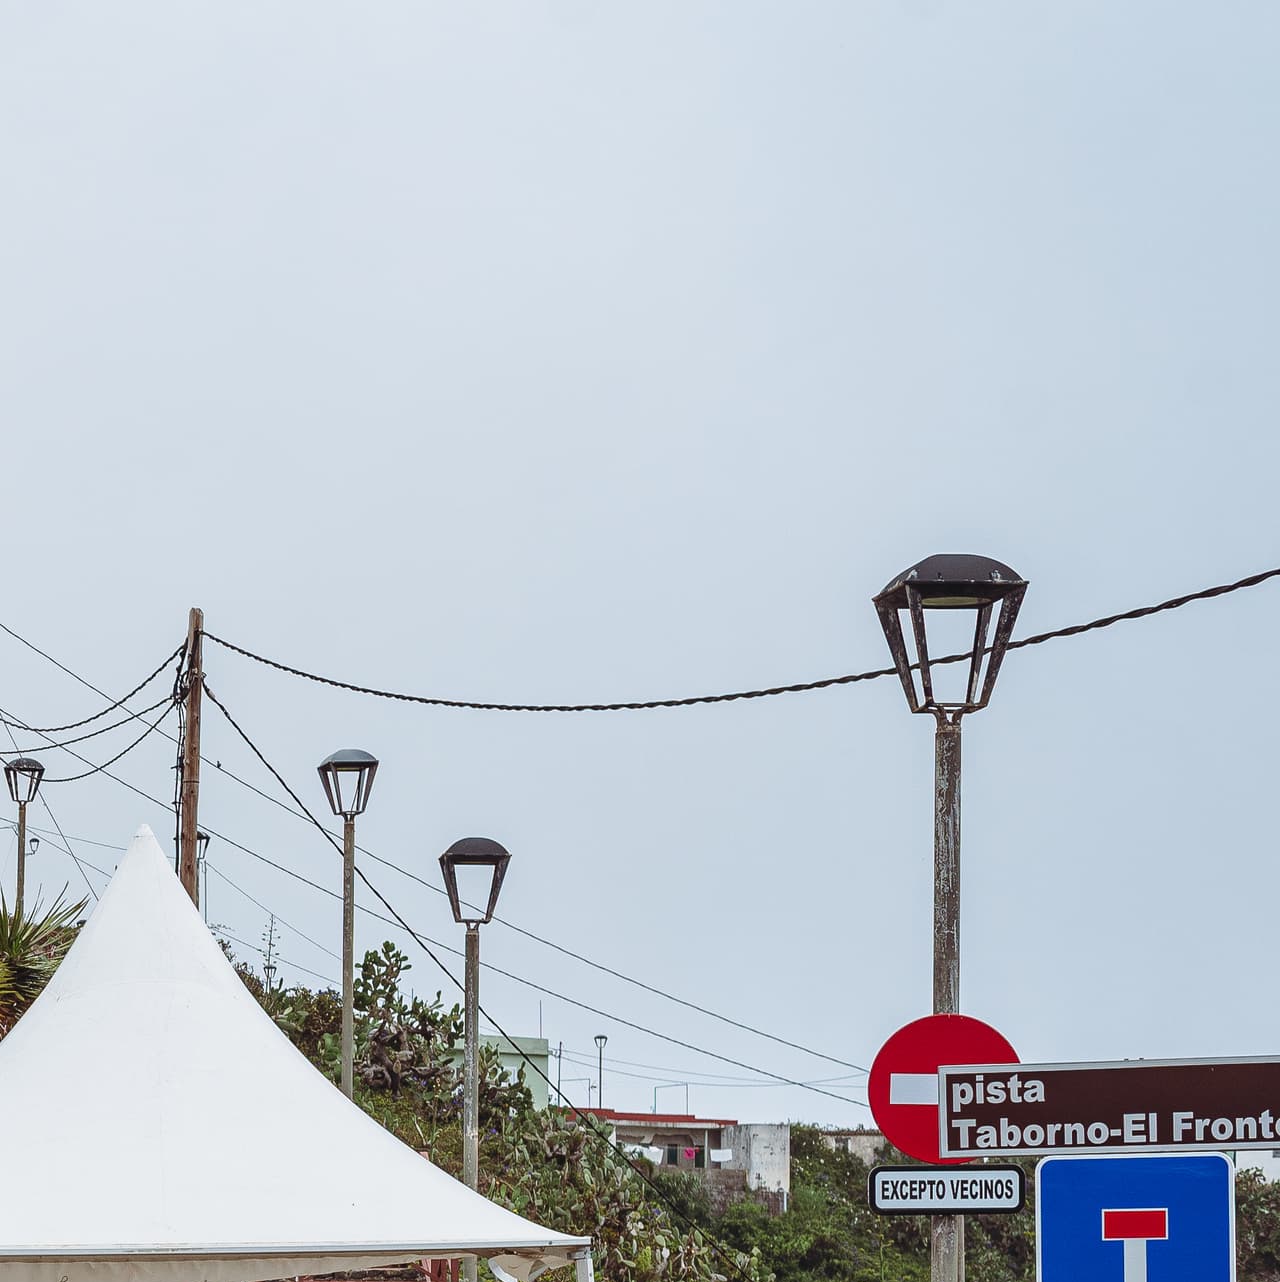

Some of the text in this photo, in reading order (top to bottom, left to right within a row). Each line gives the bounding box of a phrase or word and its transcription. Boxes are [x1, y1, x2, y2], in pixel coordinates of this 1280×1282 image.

[951, 1074, 1046, 1112] pista
[951, 1109, 1280, 1149] Taborno-El Front
[881, 1178, 1015, 1201] EXCEPTO VECINOS
